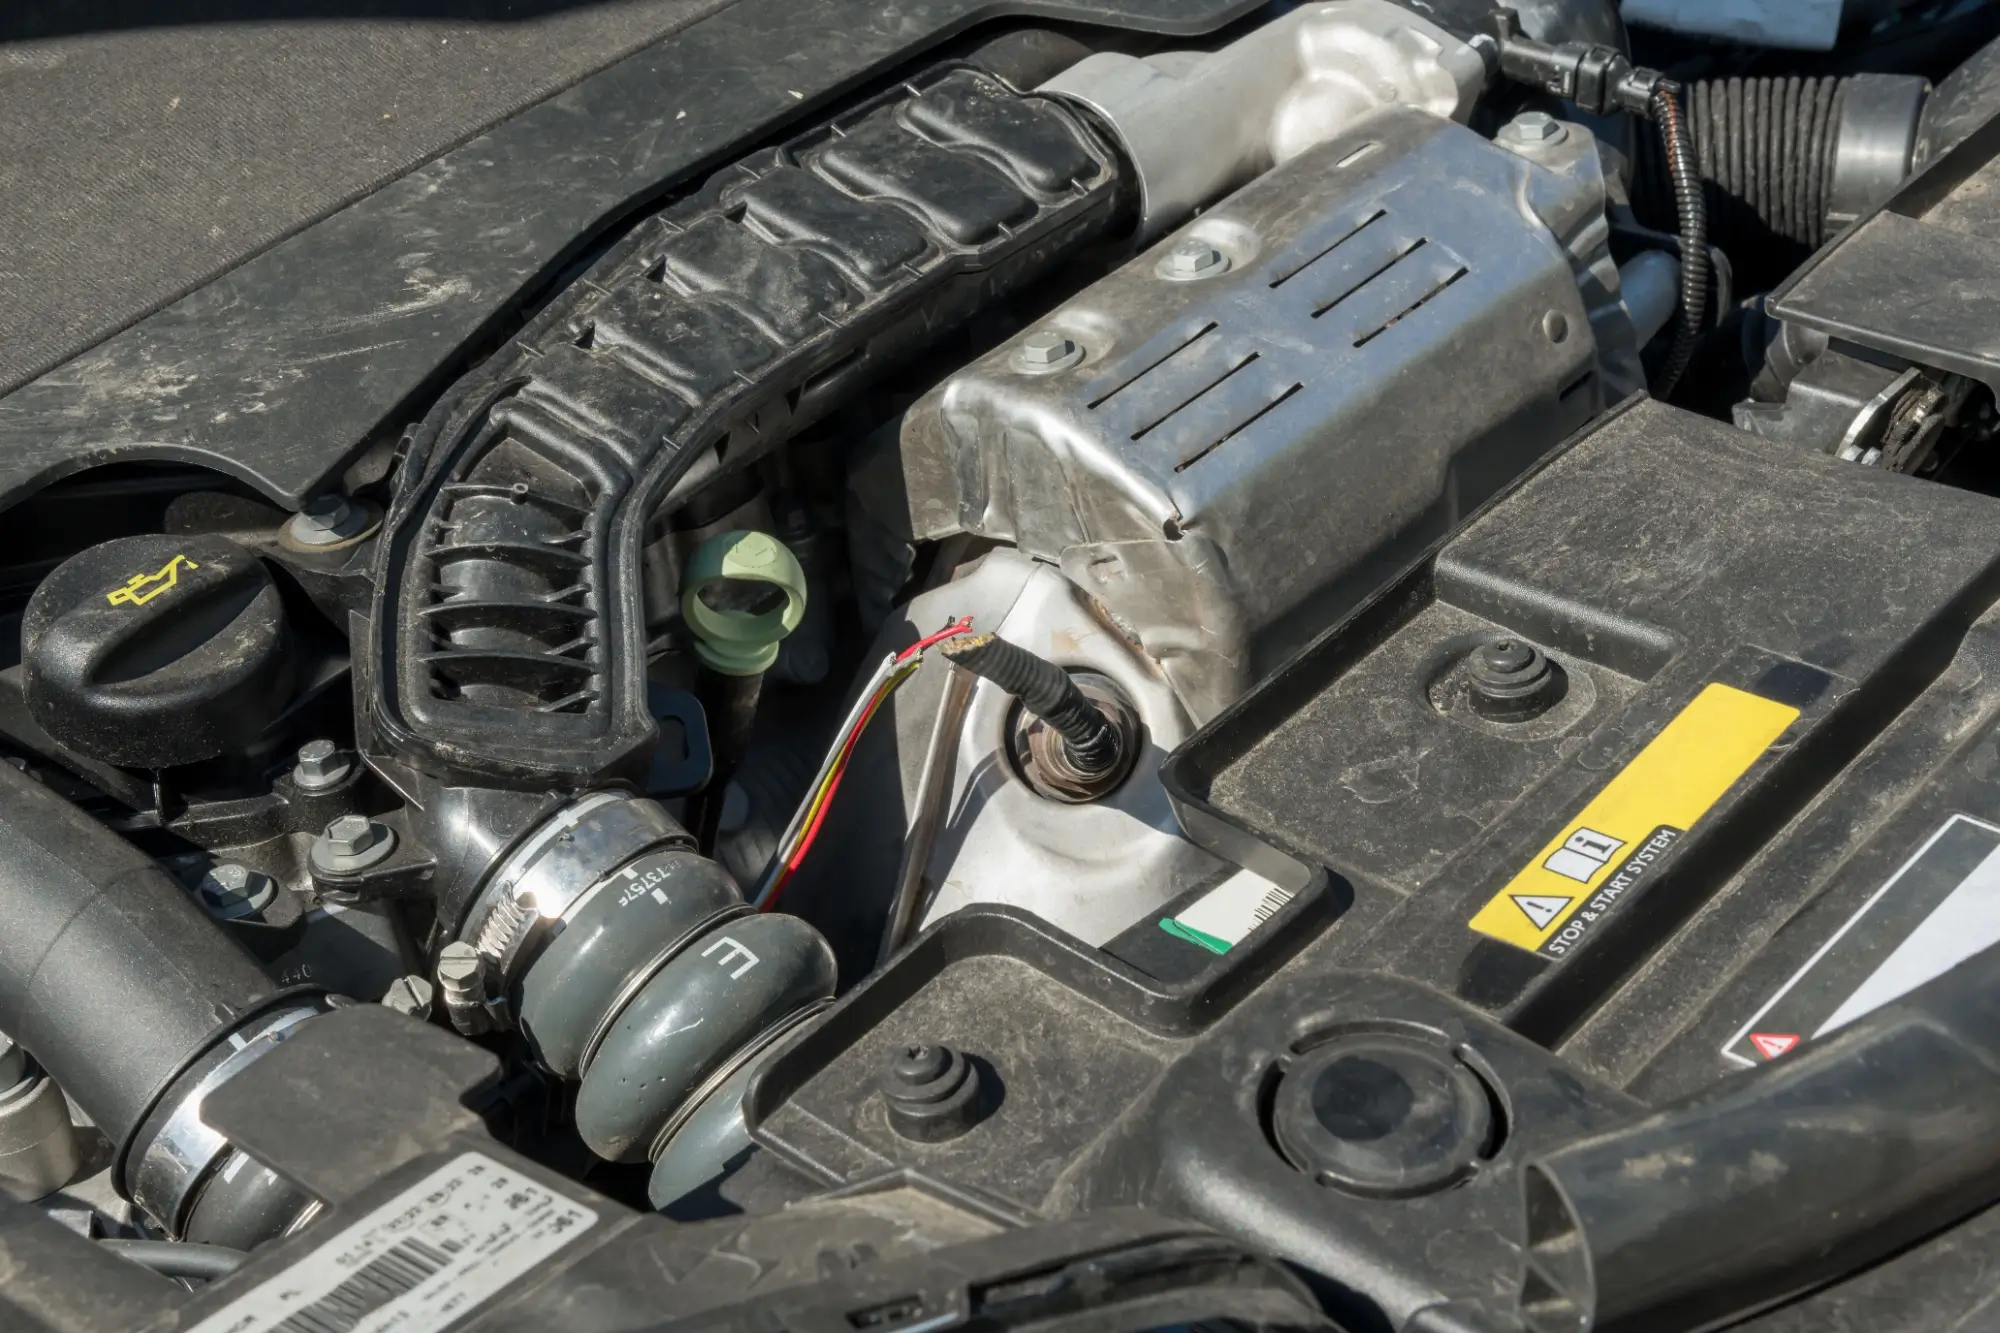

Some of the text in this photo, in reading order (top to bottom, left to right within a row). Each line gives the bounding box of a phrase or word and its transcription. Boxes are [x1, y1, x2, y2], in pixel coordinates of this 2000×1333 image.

[1548, 828, 1677, 955] STOP & START SYSTEM
